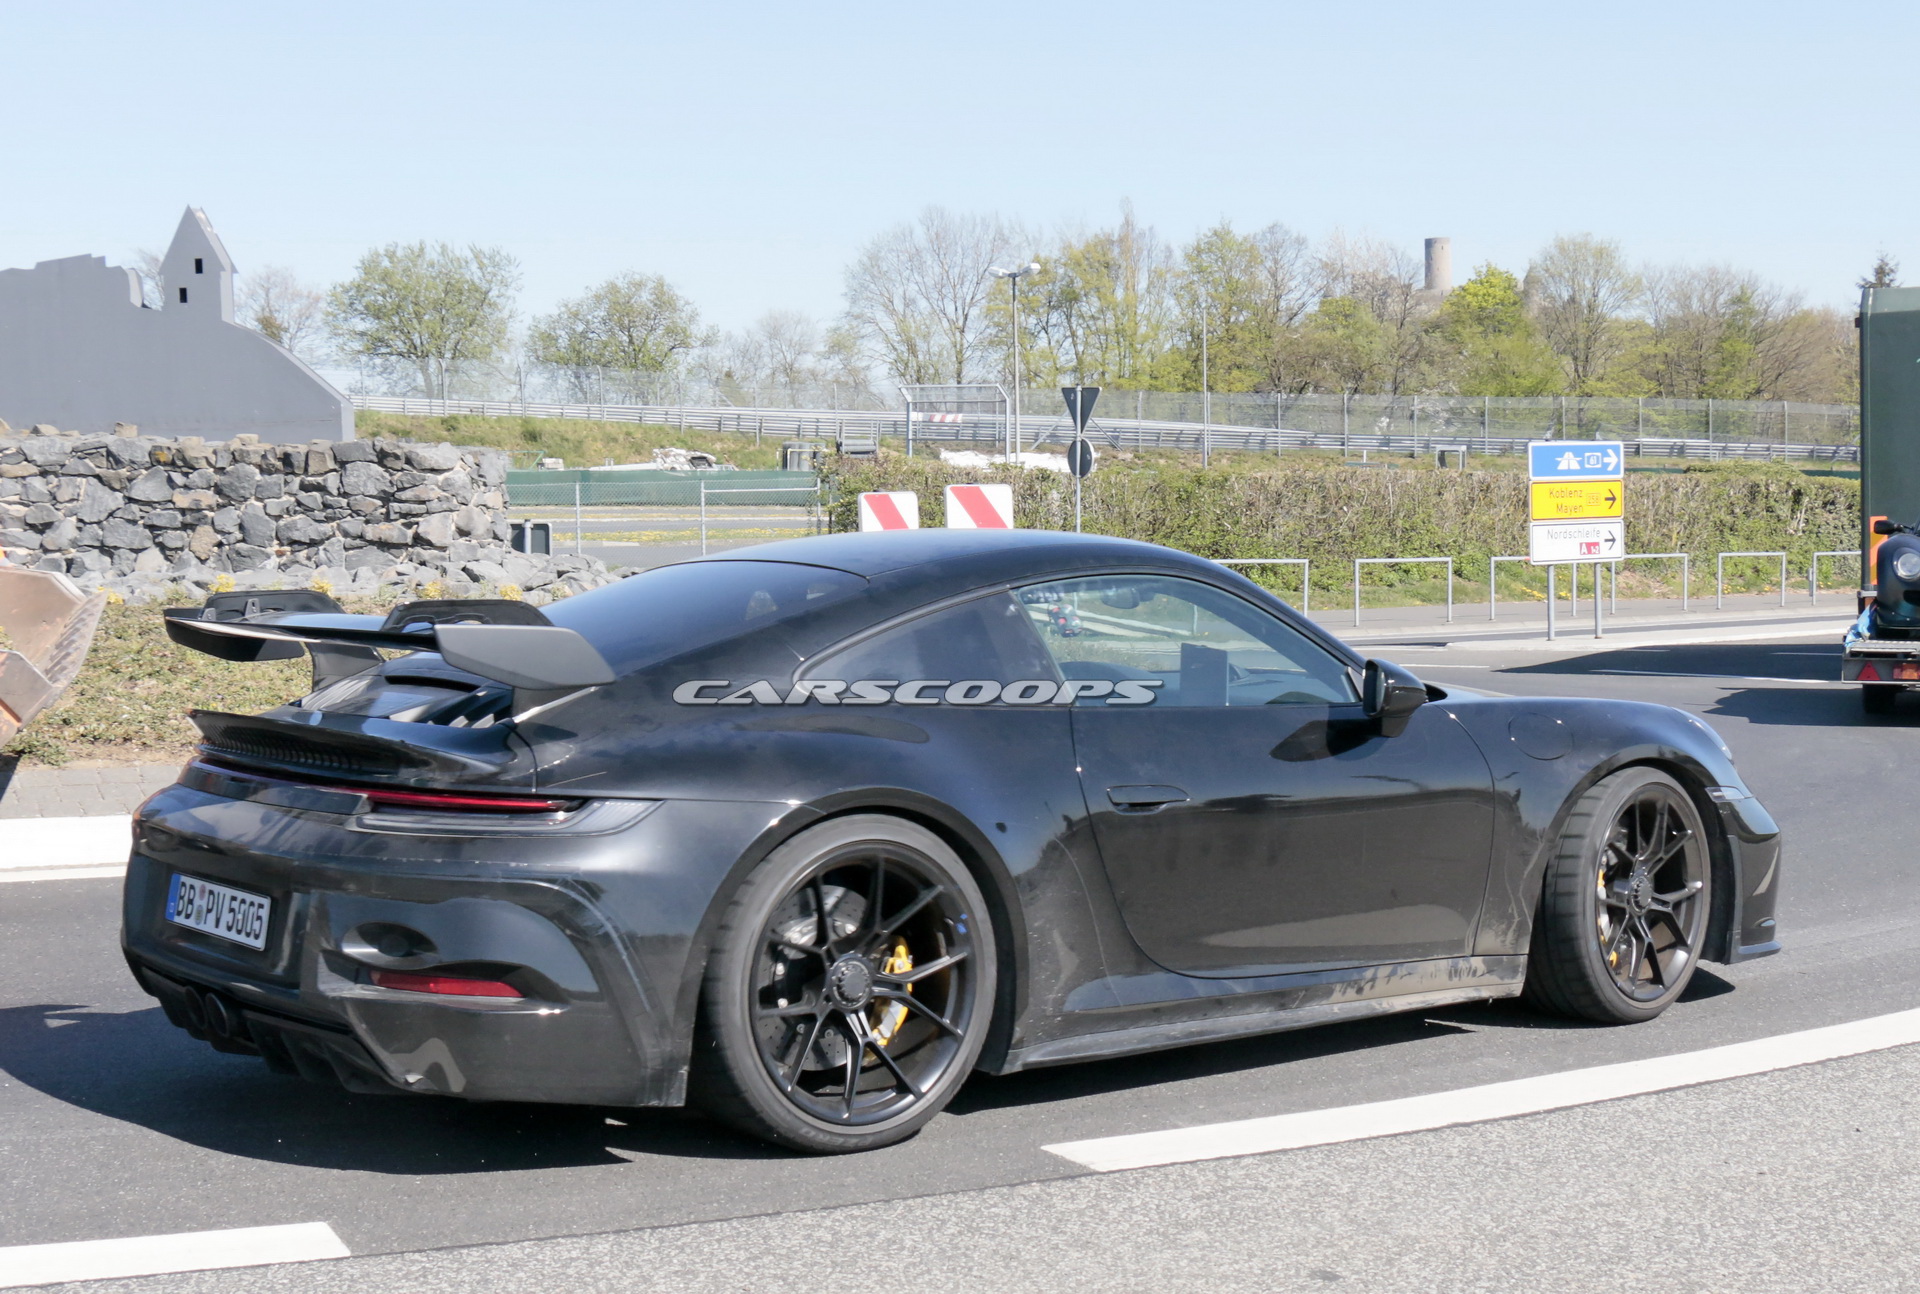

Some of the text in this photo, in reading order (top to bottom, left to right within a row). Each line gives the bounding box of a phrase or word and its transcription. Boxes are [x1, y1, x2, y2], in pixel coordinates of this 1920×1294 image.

[1549, 488, 1583, 499] Koblenz
[1556, 504, 1583, 515] Mayen
[1547, 527, 1600, 539] Nordschleife
[1581, 543, 1588, 555] A
[176, 881, 196, 919] BB
[204, 889, 226, 929] PV
